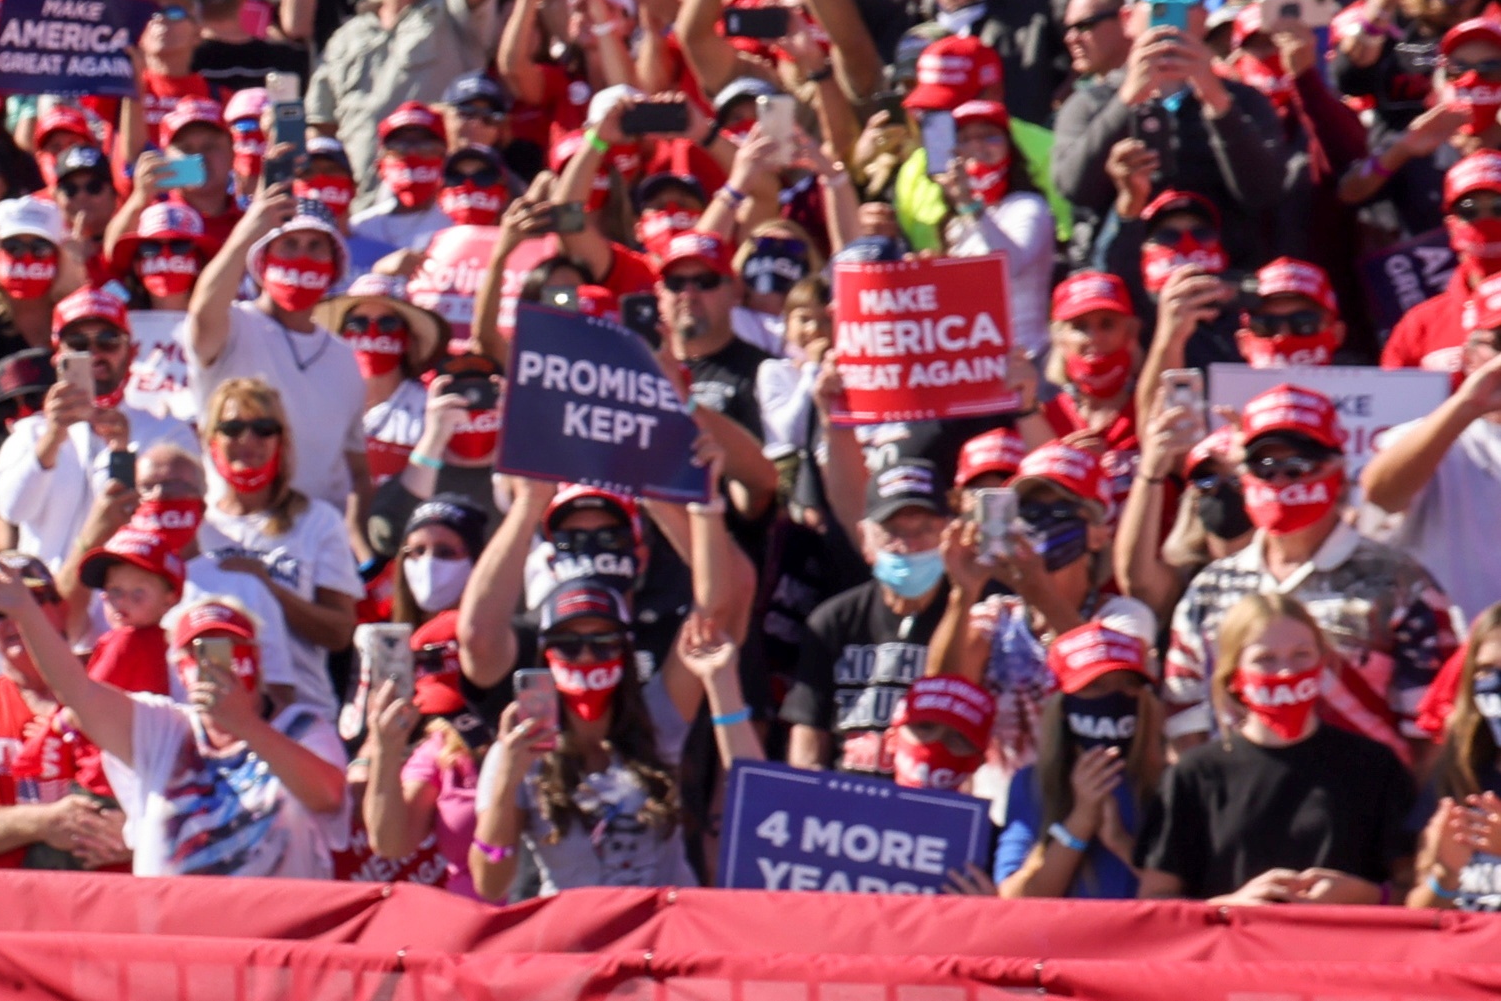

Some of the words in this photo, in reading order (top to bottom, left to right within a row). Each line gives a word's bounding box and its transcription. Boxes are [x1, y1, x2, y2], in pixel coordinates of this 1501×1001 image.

[65, 55, 133, 79] AGAIN
[859, 284, 939, 315] MAKE
[834, 311, 1004, 357] AMERICA
[516, 350, 692, 415] PROMISE
[906, 354, 1018, 388] AGAIN
[562, 400, 659, 450] KEPT
[554, 553, 634, 580] MAGA
[550, 662, 624, 691] MAGA
[1244, 677, 1319, 707] MAG
[1068, 712, 1136, 740] MAG
[755, 809, 792, 849] 4
[800, 815, 949, 877] MORE
